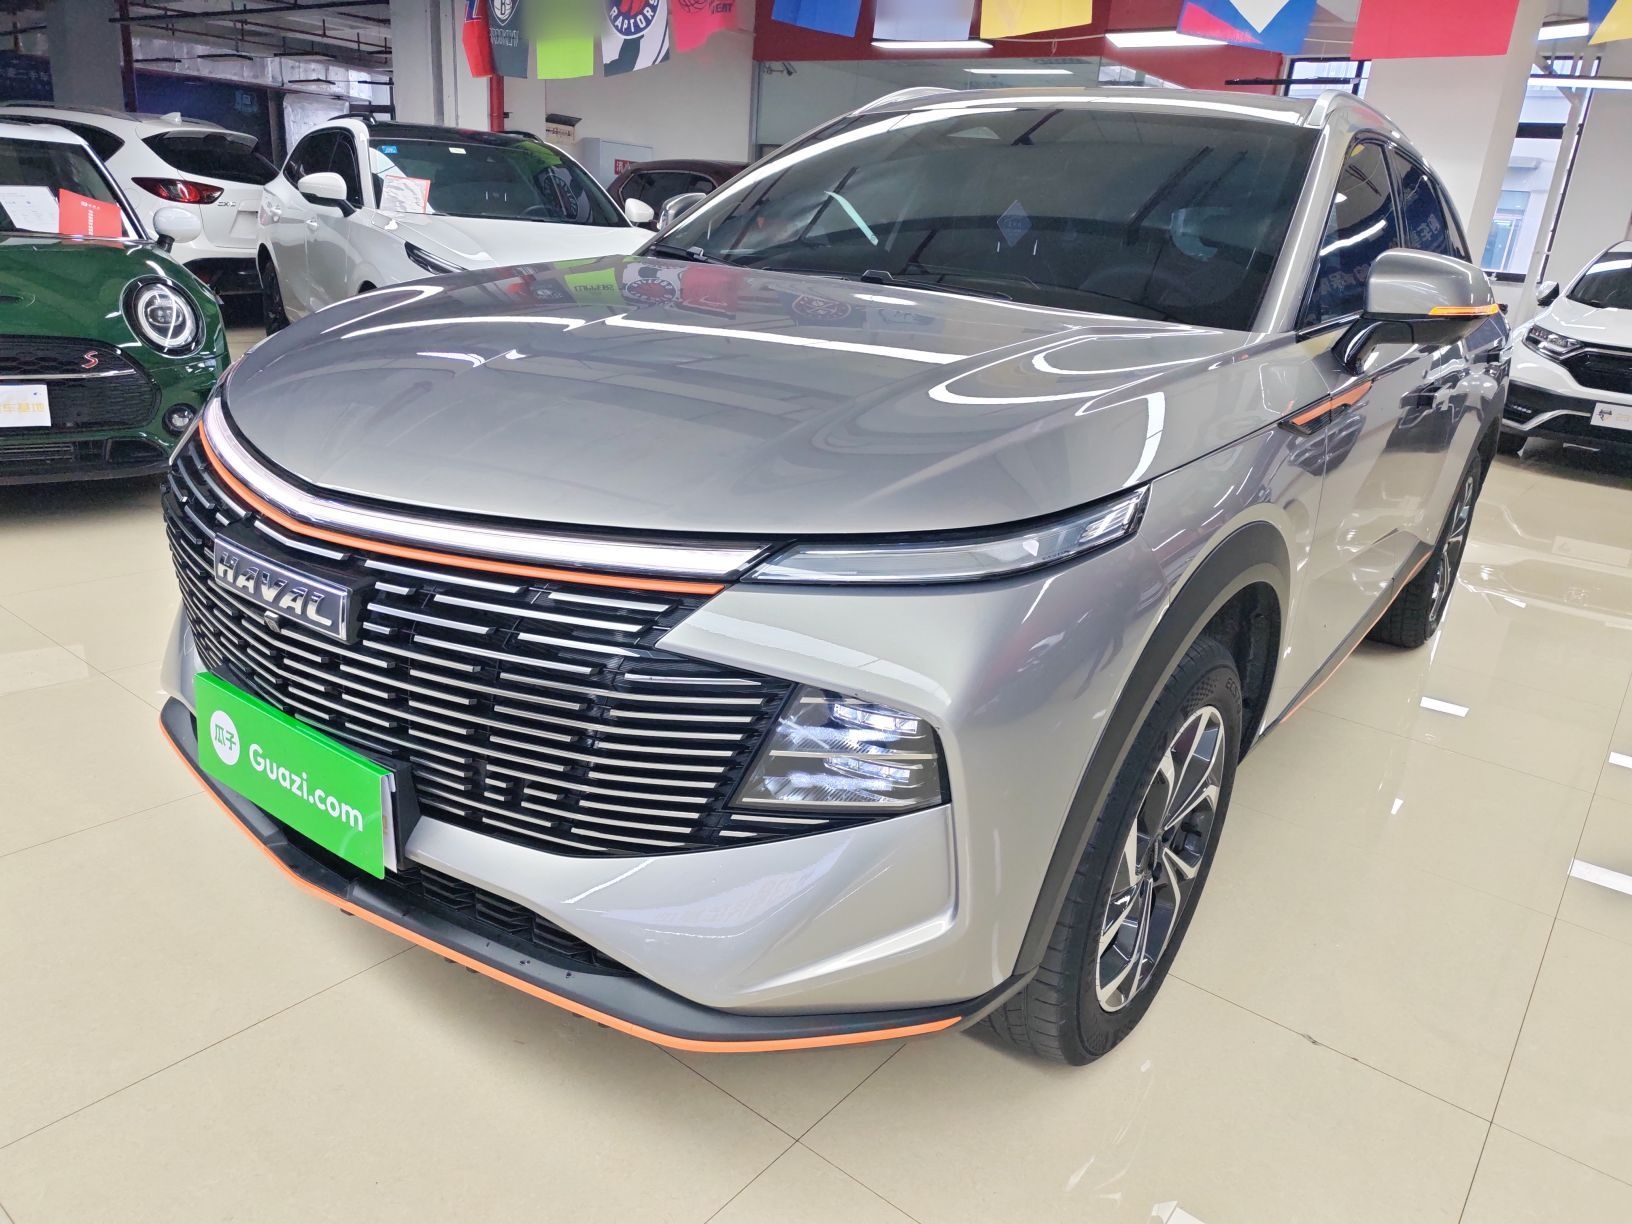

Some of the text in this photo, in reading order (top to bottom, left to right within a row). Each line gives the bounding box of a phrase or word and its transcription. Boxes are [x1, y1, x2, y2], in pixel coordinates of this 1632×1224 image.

[609, 0, 658, 33] RAPTORS
[81, 350, 99, 369] S
[217, 551, 333, 627] HAVAL
[214, 724, 364, 832] 瓜子 Guazi.com
